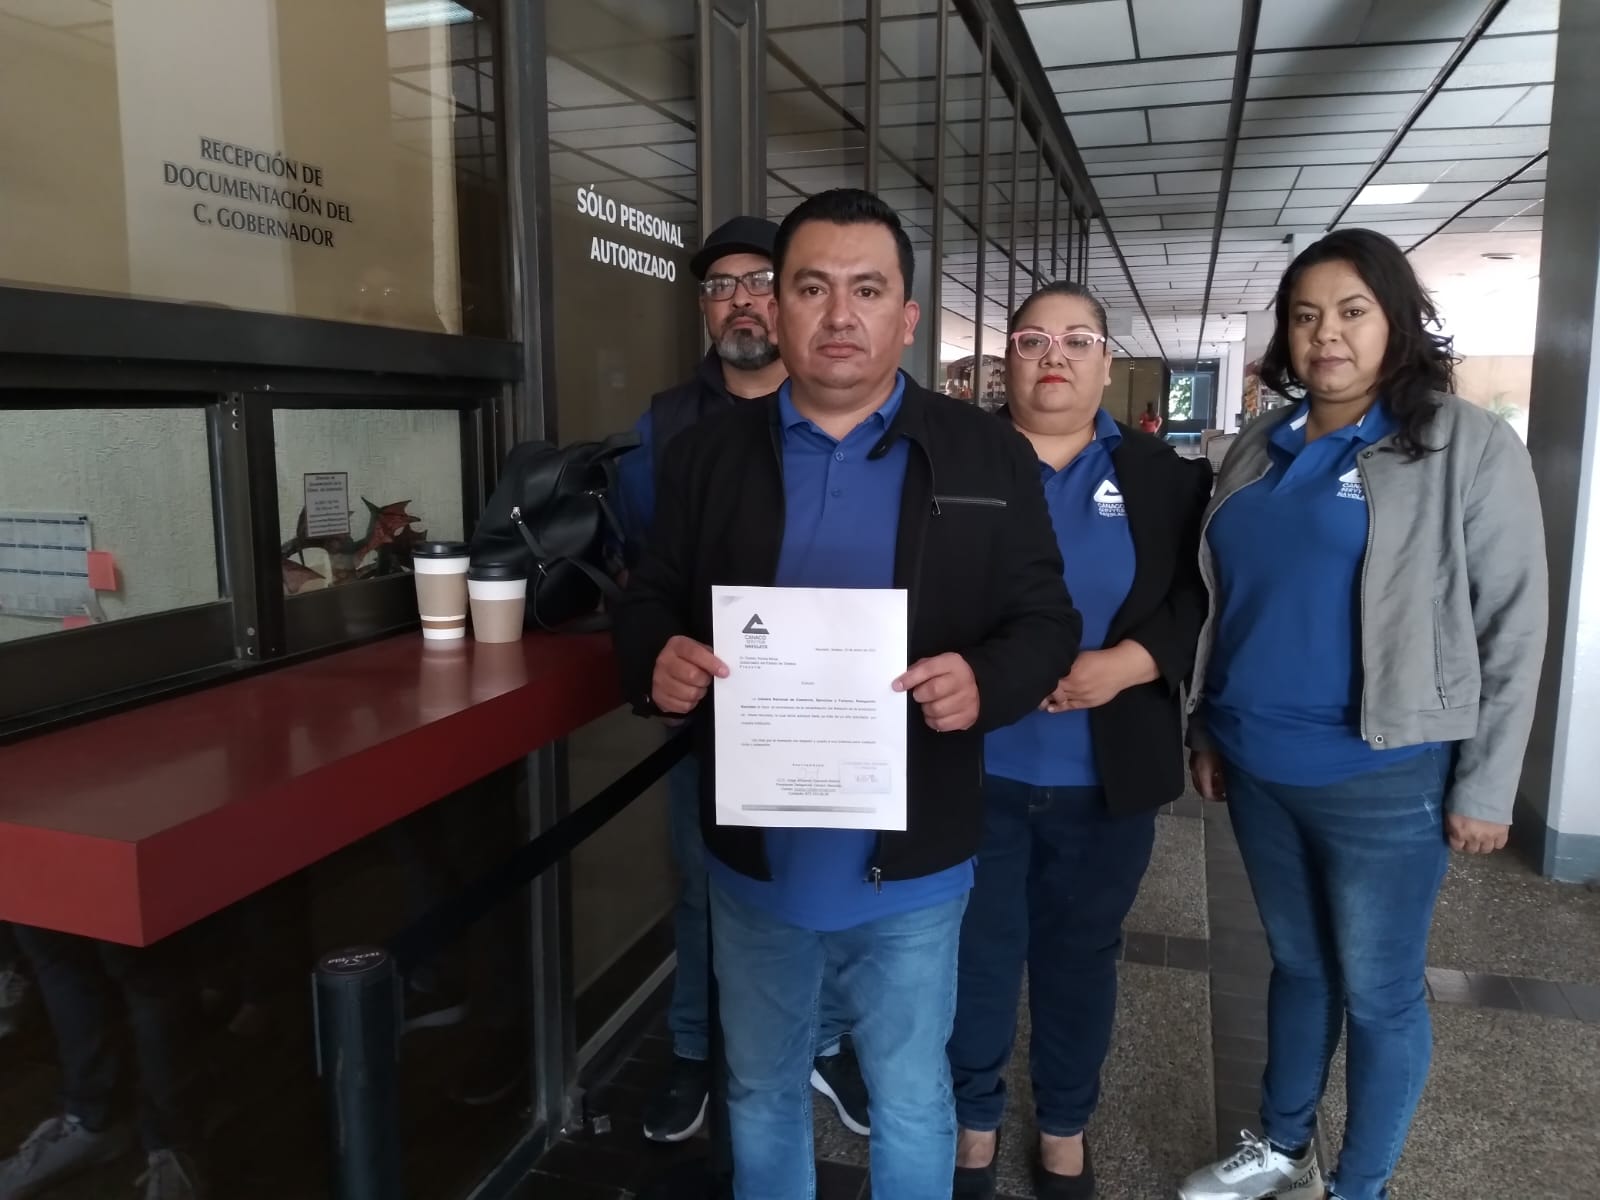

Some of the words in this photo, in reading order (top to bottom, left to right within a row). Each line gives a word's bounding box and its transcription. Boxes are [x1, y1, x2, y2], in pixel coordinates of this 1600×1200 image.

[200, 137, 298, 180] RECEPCIÓN
[303, 164, 323, 187] DE
[163, 162, 322, 216] DOCUMENTACIÓN
[327, 202, 353, 223] DEL
[577, 183, 616, 224] SÓLO
[620, 203, 685, 248] PERSONAL
[193, 203, 211, 224] C.
[217, 208, 335, 248] GOBERNADOR
[590, 236, 676, 282] AUTORIZADO
